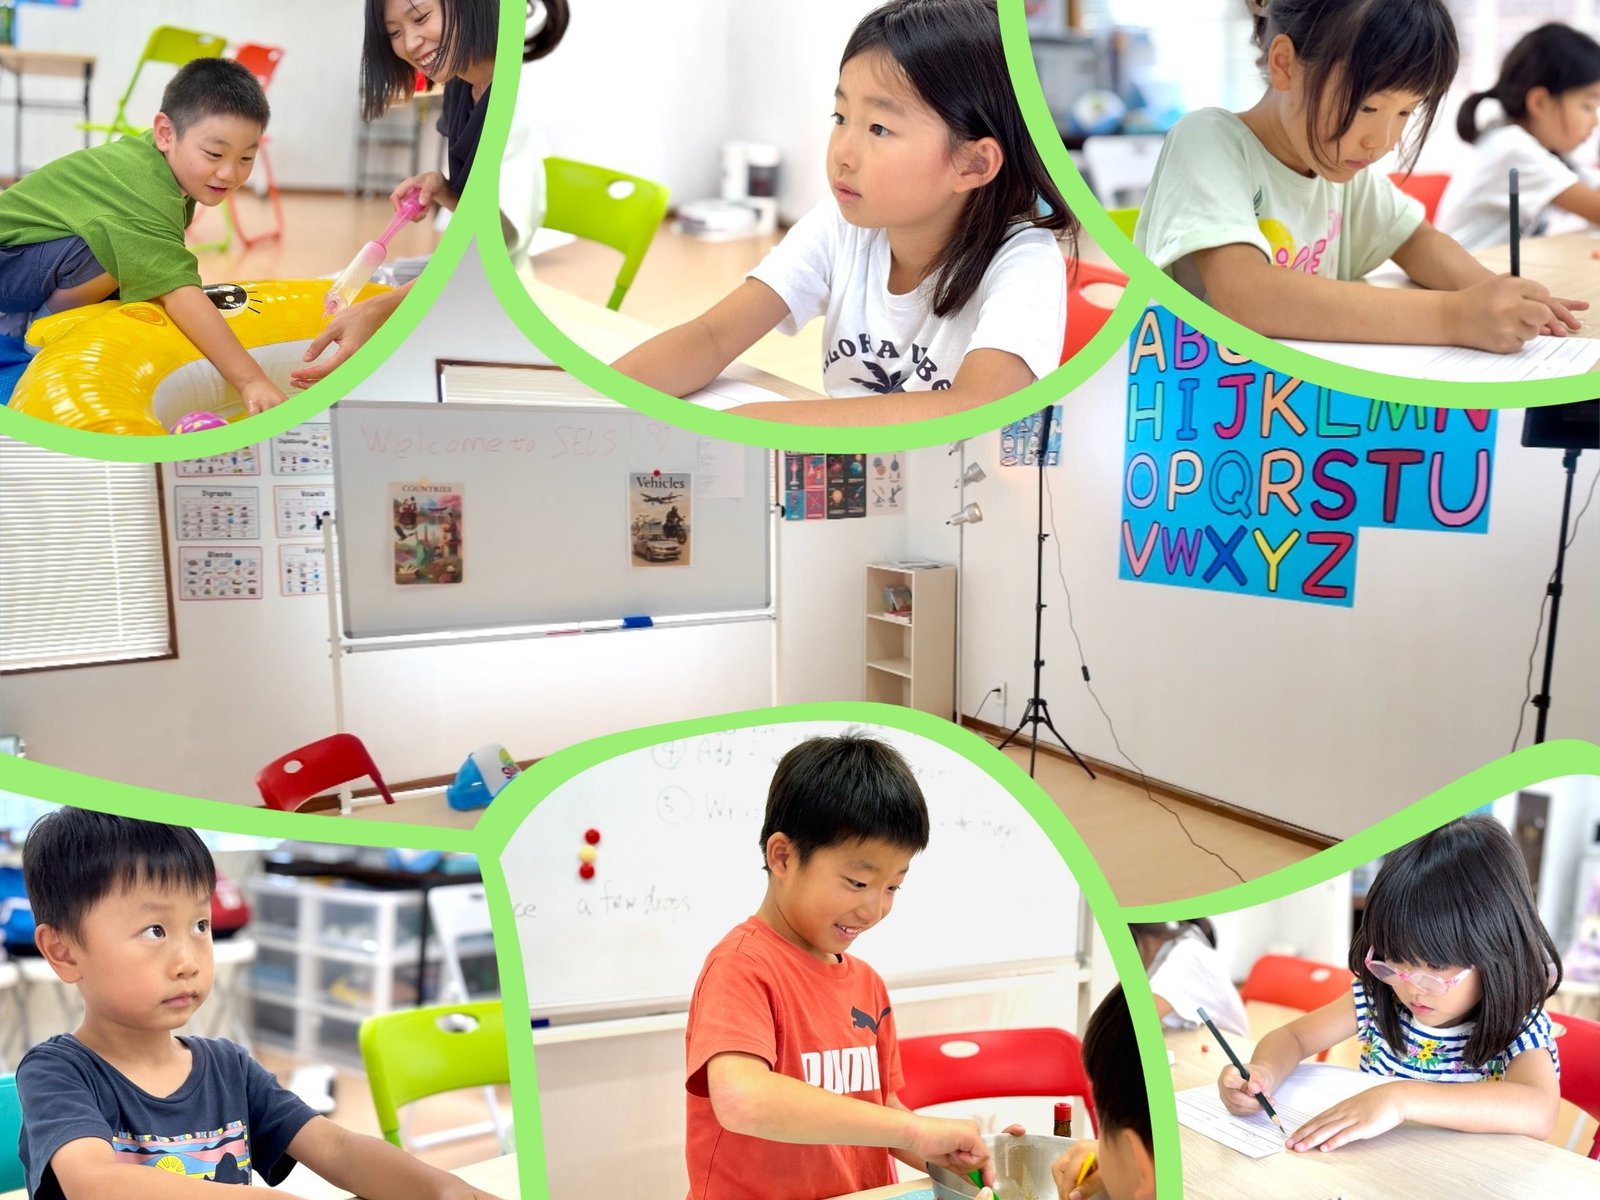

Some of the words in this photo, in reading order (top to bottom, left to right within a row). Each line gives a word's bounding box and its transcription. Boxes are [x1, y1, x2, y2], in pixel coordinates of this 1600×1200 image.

[361, 424, 501, 459] Welcome
[510, 436, 537, 453] to
[402, 484, 453, 493] COUNTRIES
[636, 476, 685, 489] Vehicles
